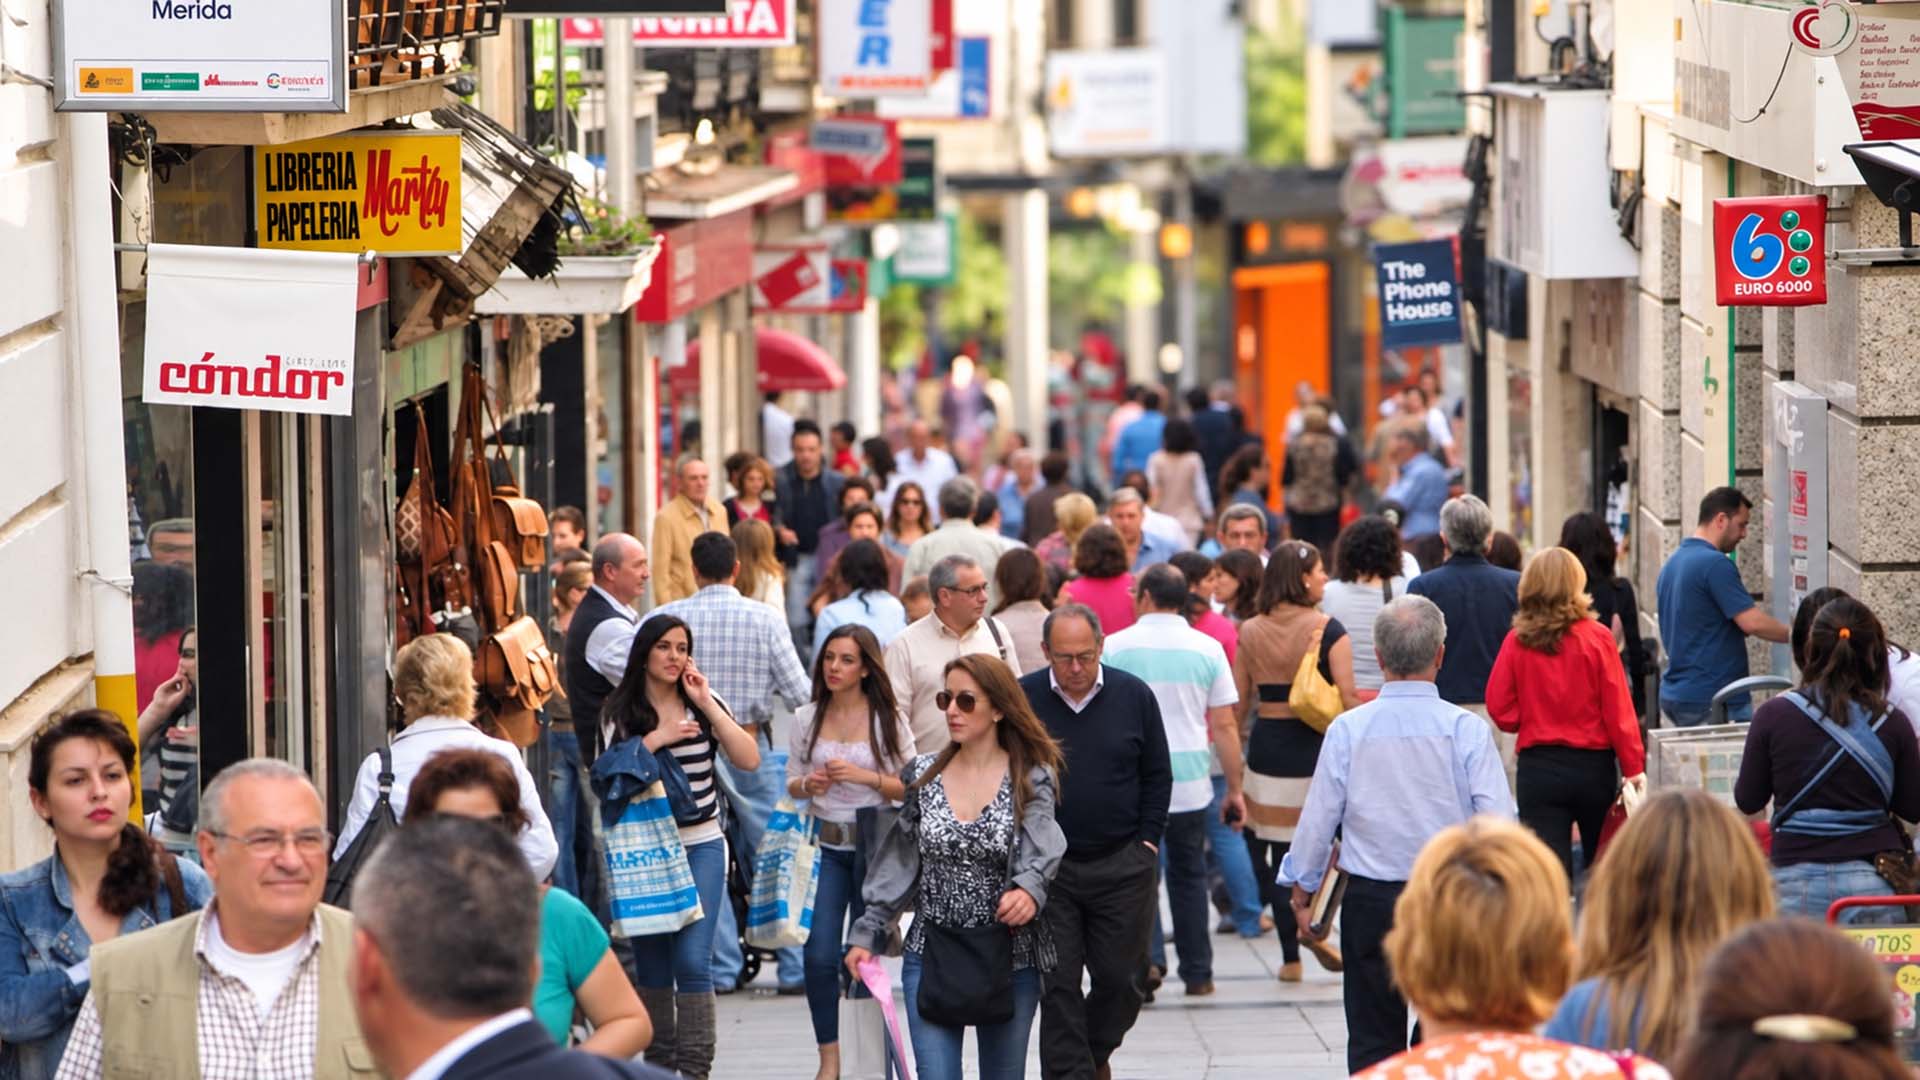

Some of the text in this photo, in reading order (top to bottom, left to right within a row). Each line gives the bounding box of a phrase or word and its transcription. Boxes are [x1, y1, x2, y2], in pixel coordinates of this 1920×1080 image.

[265, 151, 357, 192] LIBRERIA
[266, 201, 361, 242] PAPELERIA
[1382, 260, 1426, 280] The
[1384, 280, 1452, 302] Phone
[1734, 280, 1813, 295] EURO 6000
[1386, 300, 1454, 322] House
[159, 352, 344, 401] cóndor
